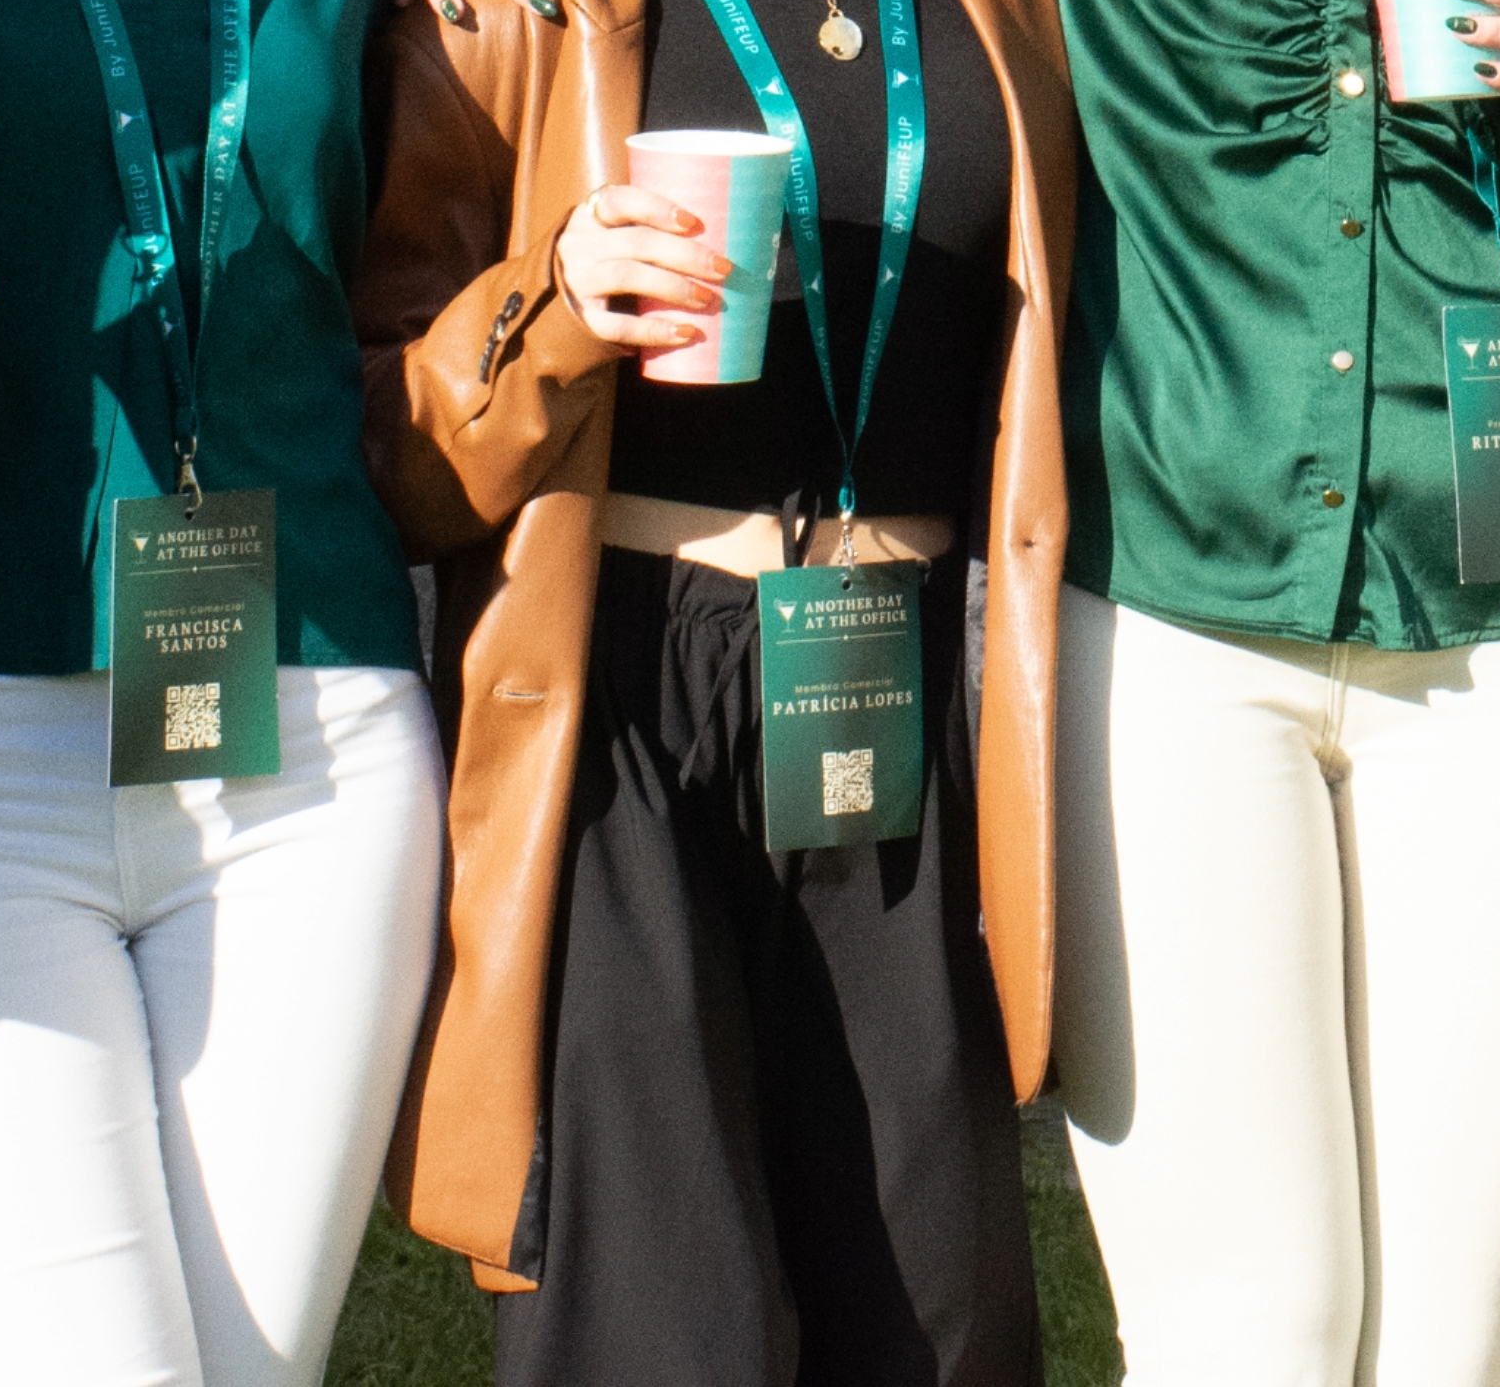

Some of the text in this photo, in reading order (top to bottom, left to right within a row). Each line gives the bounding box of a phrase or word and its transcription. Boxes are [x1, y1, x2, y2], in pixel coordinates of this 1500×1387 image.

[891, 25, 908, 46] By
[223, 49, 239, 88] THE
[221, 101, 237, 127] AT
[213, 135, 232, 181] DAY
[897, 115, 914, 203] JuniFEUP
[157, 524, 259, 545] ANOTHER DAY
[156, 541, 263, 562] AT THE OFFICE
[804, 594, 903, 614] ANOTHER DAY
[145, 618, 243, 640] FRANCISCA
[804, 609, 908, 630] AT THE OFFICE
[160, 635, 228, 654] SANTOS
[772, 691, 914, 716] PATRÍCIA LOPES
